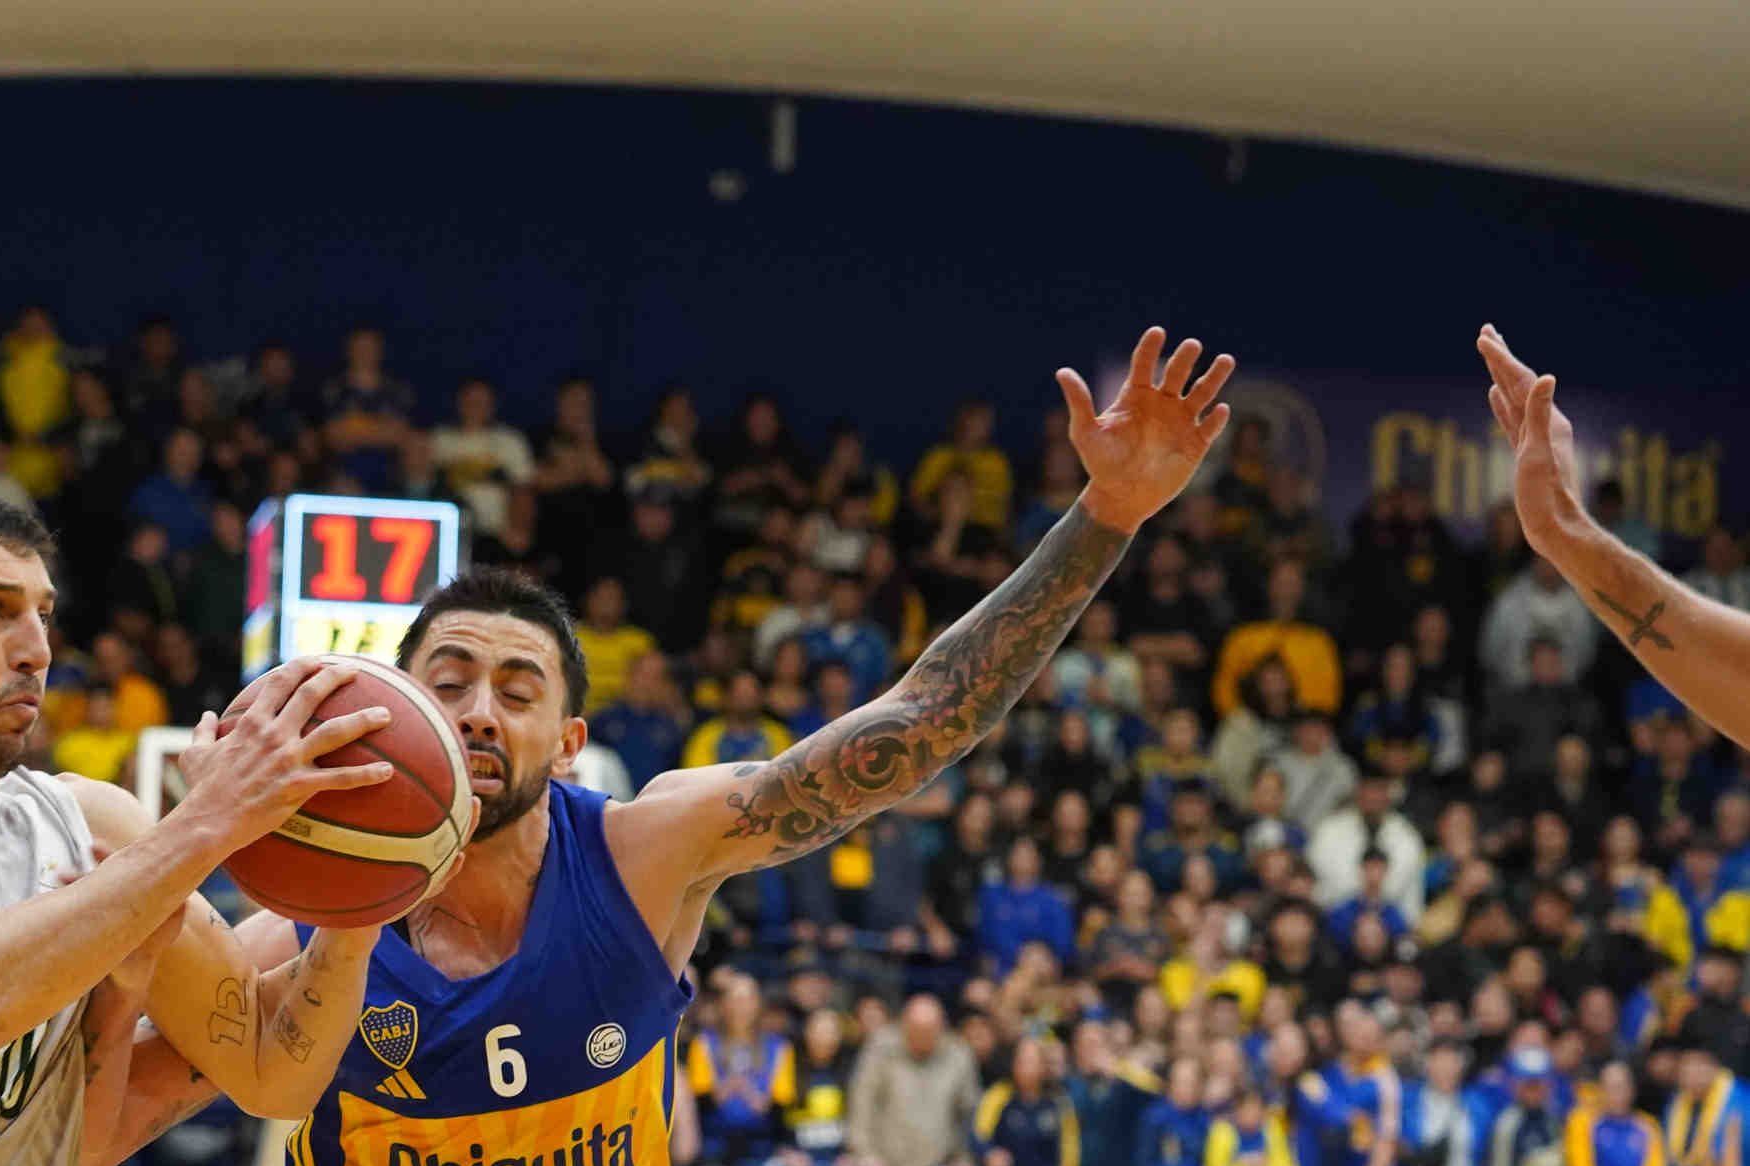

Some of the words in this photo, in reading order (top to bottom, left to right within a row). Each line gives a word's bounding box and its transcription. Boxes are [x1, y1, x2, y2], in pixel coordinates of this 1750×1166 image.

[310, 515, 435, 604] 17
[369, 1022, 412, 1043] CABJ
[484, 1023, 529, 1099] 6
